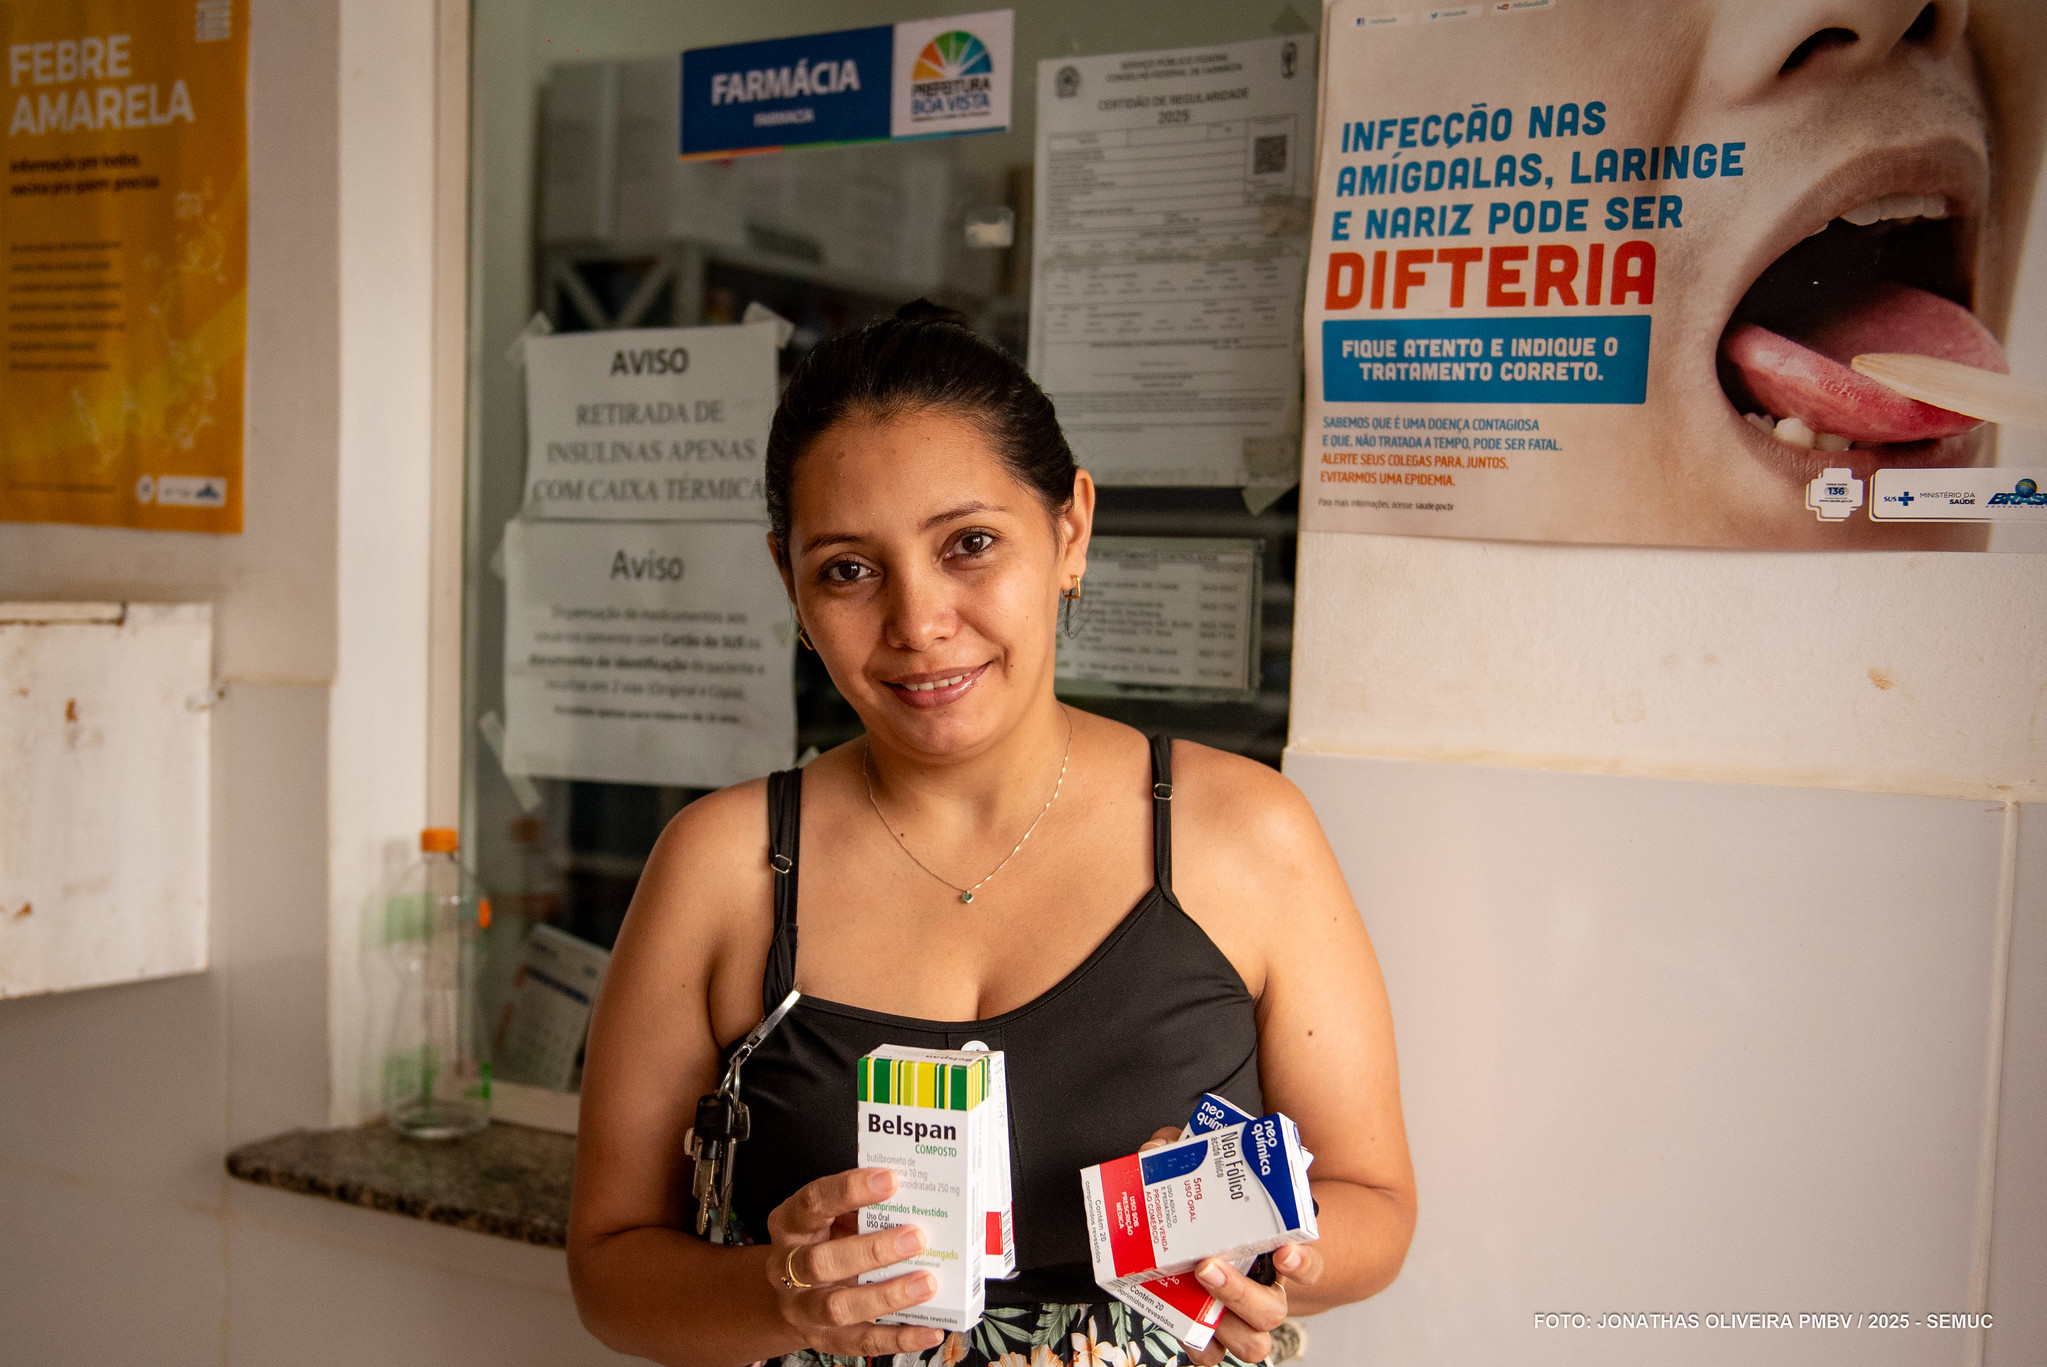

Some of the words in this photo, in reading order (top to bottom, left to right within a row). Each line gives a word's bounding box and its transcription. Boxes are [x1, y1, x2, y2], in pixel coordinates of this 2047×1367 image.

[9, 33, 132, 86] FEBRE
[711, 57, 860, 107] FARMÁCIA
[911, 77, 991, 98] PREFEITURA
[9, 79, 195, 136] AMARELA
[911, 97, 943, 115] BOA
[946, 92, 990, 112] VISTA
[1341, 102, 1513, 154] INFECÇÃO
[1528, 100, 1607, 140] NAS
[1335, 151, 1554, 199] AMÍGDALAS,
[1570, 141, 1747, 185] LARINGE
[1330, 210, 1353, 242] E
[1364, 203, 1475, 241] NARIZ
[1487, 197, 1590, 236] PODE
[1603, 194, 1684, 231] SER
[1325, 239, 1657, 312] DIFTERIA
[1341, 338, 1397, 360] FIQUE
[1402, 338, 1484, 358] ATENTO
[1490, 338, 1504, 357] E
[1511, 337, 1596, 358] INDIQUE
[1603, 336, 1619, 356] O
[610, 347, 690, 377] AVISO
[1358, 361, 1493, 382] TRATAMENTO
[1499, 361, 1605, 382] CORRETO.
[575, 401, 689, 427] RETIRADA
[693, 399, 725, 423] DE
[1322, 416, 1370, 429] SABEMOS
[1372, 417, 1392, 430] QUE
[1394, 414, 1400, 429] É
[1402, 417, 1426, 430] UMA
[1428, 418, 1470, 434] DOENÇA
[1472, 418, 1540, 431] CONTAGIOSA
[547, 439, 663, 465] INSULINAS
[667, 437, 758, 463] APENAS
[1322, 434, 1328, 447] E
[1355, 433, 1376, 447] NÃO
[1379, 435, 1422, 448] TRATADA
[1424, 436, 1431, 448] A
[1473, 437, 1502, 450] PODE
[1504, 438, 1526, 451] SER
[1528, 438, 1563, 451] FATAL.
[1321, 453, 1358, 465] ALERTE
[1360, 453, 1386, 466] SEUS
[1388, 454, 1432, 467] COLEGAS
[1466, 456, 1509, 470] JUNTOS,
[532, 478, 584, 502] COM
[587, 478, 660, 502] CAIXA
[662, 472, 766, 502] TÉRMICA
[1320, 470, 1377, 484] EVITARMOS
[1379, 472, 1402, 485] UMA
[1404, 473, 1456, 486] EPIDEMIA.
[1318, 497, 1332, 506] Para
[1827, 487, 1845, 496] 136
[1883, 495, 1897, 503] SUS
[1919, 490, 1961, 499] MINISTÉRIO
[1949, 497, 1976, 506] SAÚDE
[609, 548, 685, 583] Aviso
[1200, 1101, 1225, 1120] neo
[867, 1113, 957, 1143] Belspan
[1264, 1119, 1278, 1148] neo
[914, 1144, 957, 1158] COMPOSTO
[1210, 1136, 1220, 1157] ácido
[1220, 1130, 1239, 1159] Neo
[1250, 1122, 1271, 1177] química
[866, 1152, 907, 1166] butilbrometo
[907, 1157, 916, 1167] de
[1214, 1157, 1225, 1179] fólico
[909, 1168, 917, 1178] 10
[917, 1171, 928, 1182] mg
[937, 1182, 949, 1193] 250
[949, 1186, 960, 1197] mg
[1145, 1191, 1153, 1203] AO
[1166, 1184, 1174, 1198] USO
[1183, 1179, 1193, 1197] USO
[1193, 1176, 1204, 1200] 5mg
[866, 1201, 910, 1214] Comprimidos
[911, 1204, 948, 1218] Revestidos
[1121, 1191, 1134, 1237] PRESCRIÇÃO
[1129, 1195, 1137, 1212] USO
[1169, 1198, 1178, 1224] ADULTO
[1185, 1197, 1196, 1223] ORAL
[866, 1212, 877, 1221] Uso
[878, 1213, 890, 1222] Oral
[866, 1220, 879, 1229] USO
[1084, 1180, 1096, 1226] comprimidos
[1091, 1226, 1102, 1264] revestidos
[1094, 1198, 1104, 1231] Contém
[1099, 1231, 1107, 1243] 20
[1115, 1201, 1125, 1230] MÉDICA
[1131, 1212, 1140, 1228] SOB
[1147, 1203, 1160, 1244] COMÉRCIO
[1153, 1188, 1164, 1225] PROIBIDA
[1159, 1225, 1169, 1253] VENDA
[914, 1259, 940, 1268] abdominal
[1129, 1284, 1155, 1306] Contém
[1154, 1301, 1165, 1312] 20
[895, 1312, 929, 1321] comprimidos
[929, 1316, 958, 1325] revestidos
[1144, 1304, 1175, 1330] revestidos
